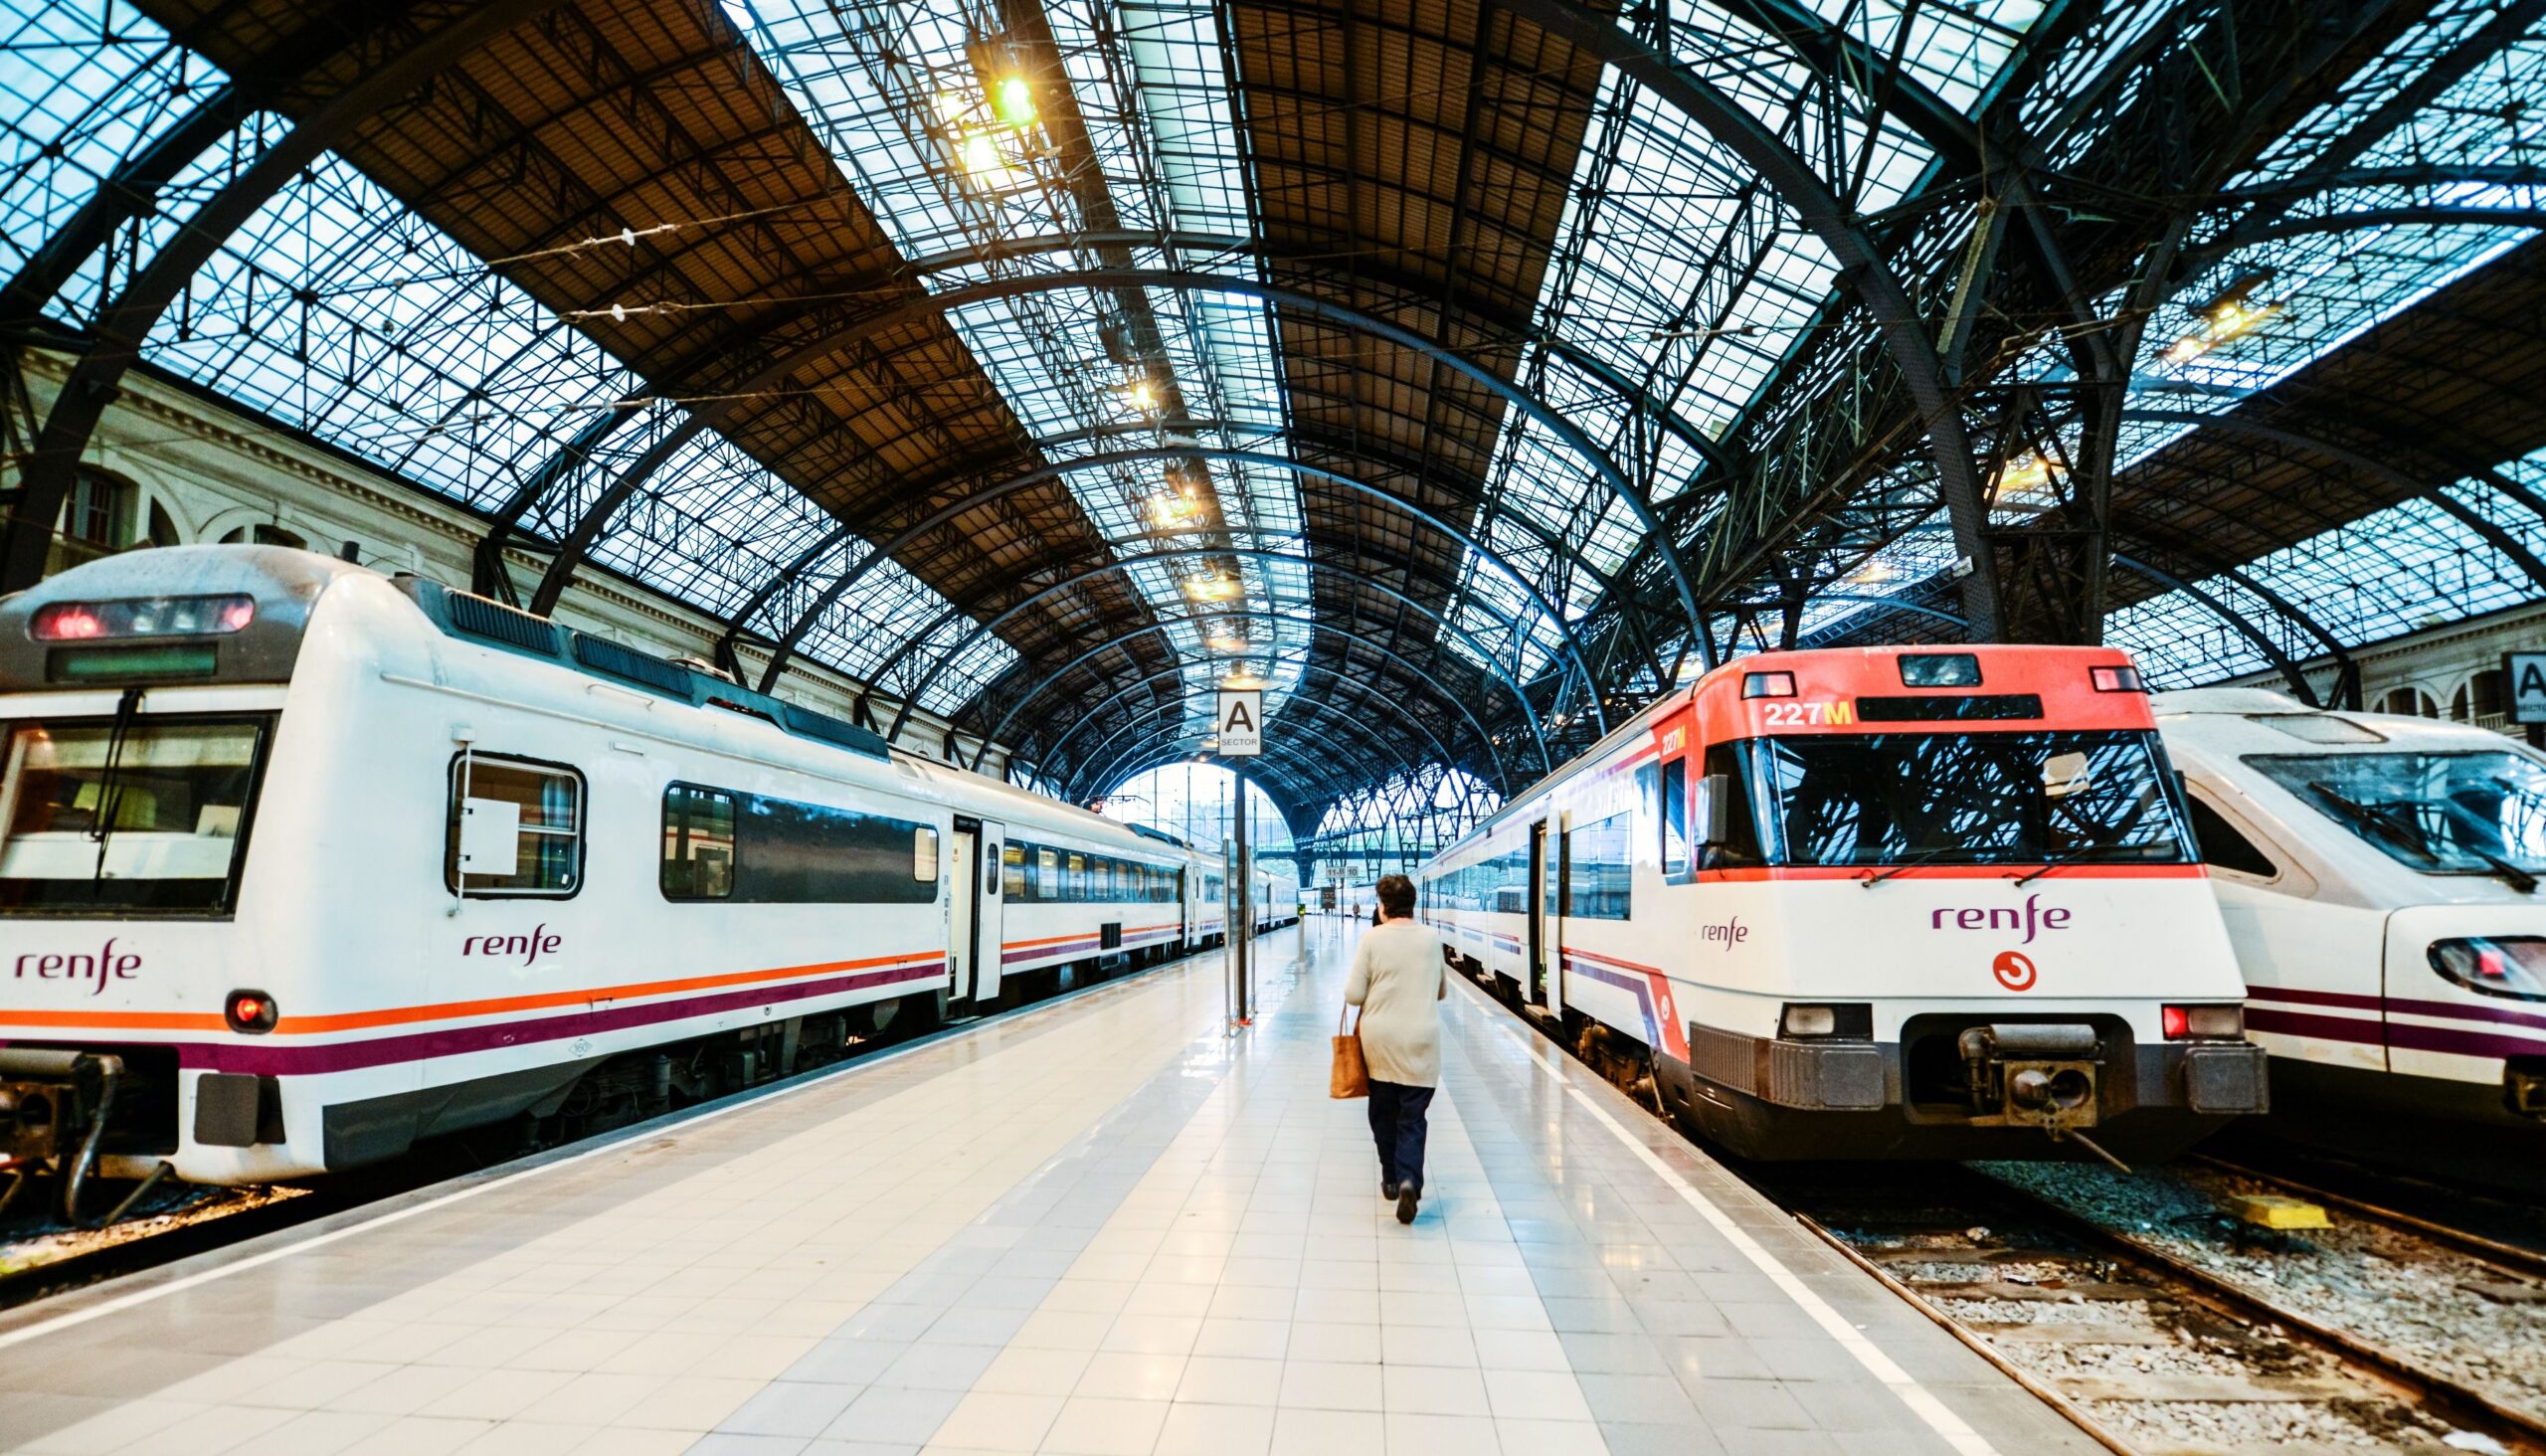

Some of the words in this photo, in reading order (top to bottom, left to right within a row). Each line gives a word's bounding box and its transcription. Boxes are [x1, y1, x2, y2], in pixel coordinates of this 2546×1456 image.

[2519, 662, 2546, 698] A
[1225, 700, 1254, 733] A
[1764, 700, 1853, 726] 227M
[1662, 725, 1686, 757] 227M
[1701, 915, 1748, 952] renfe
[1932, 893, 2072, 945] renfe
[461, 922, 562, 967] renfe
[14, 936, 142, 997] renfe
